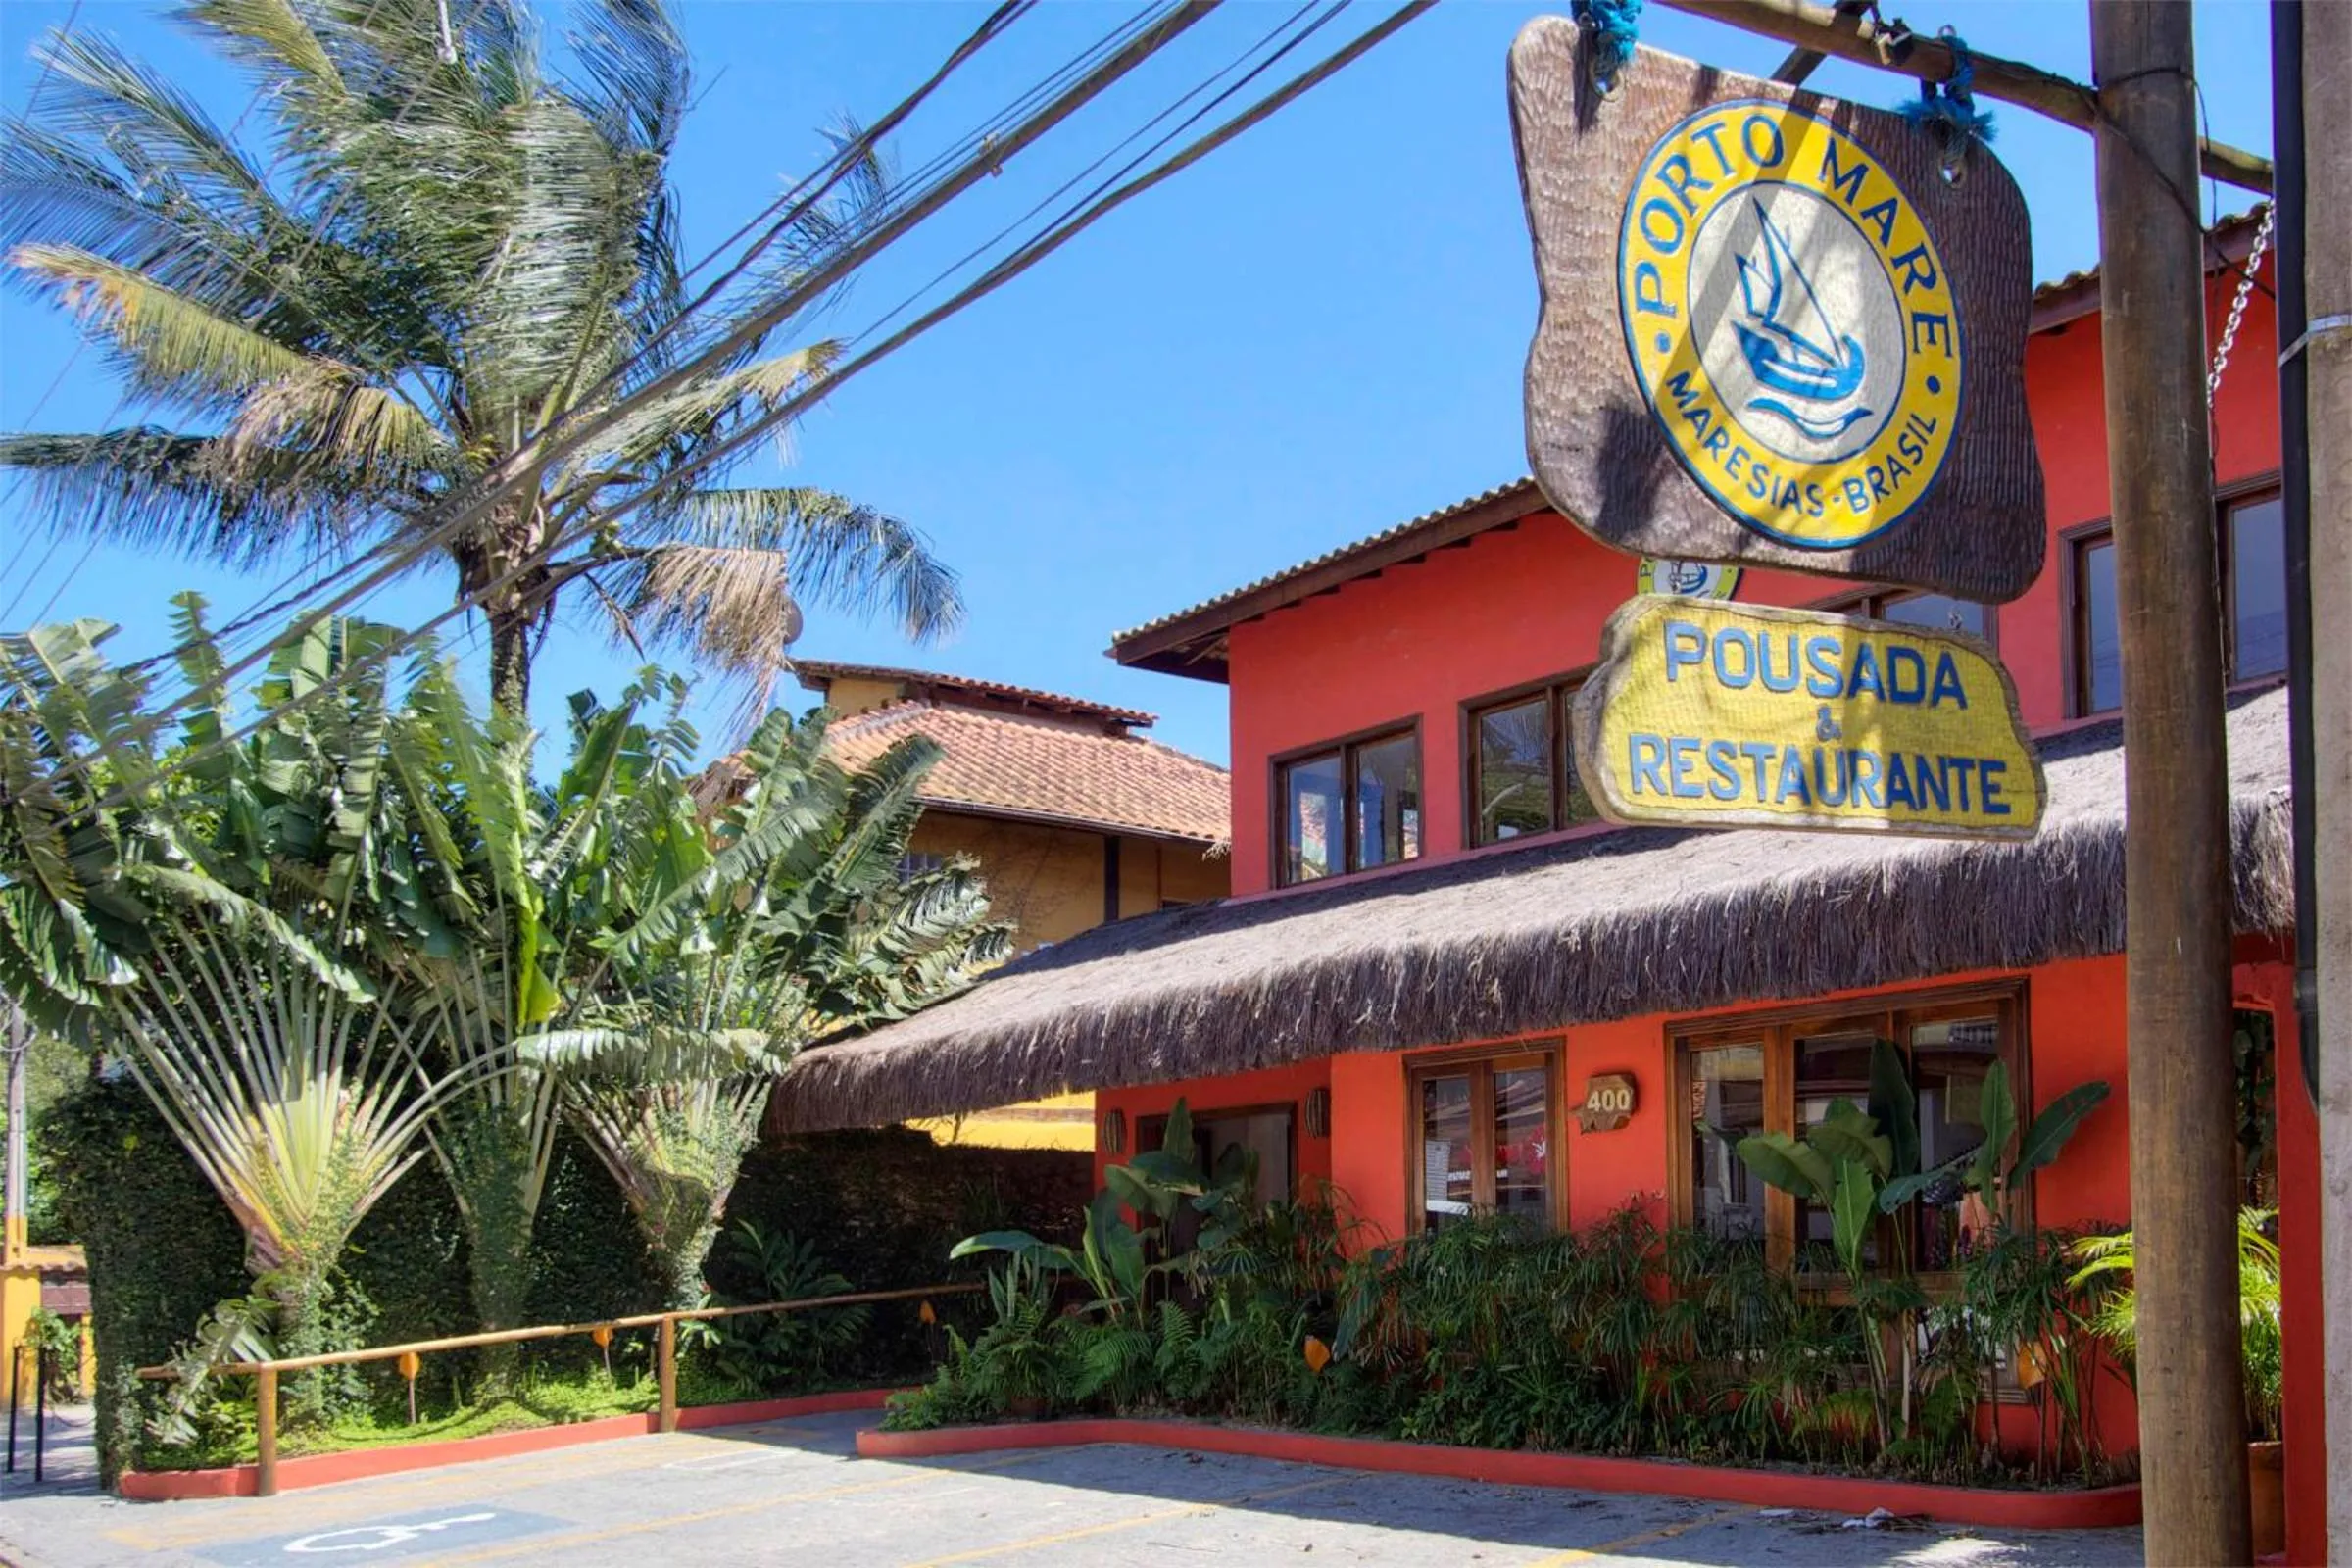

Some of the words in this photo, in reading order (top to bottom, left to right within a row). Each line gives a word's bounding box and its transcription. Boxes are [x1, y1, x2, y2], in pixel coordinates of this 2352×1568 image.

[1635, 113, 1785, 318] PORTO
[1819, 137, 1953, 358] MARE
[1665, 370, 1825, 517] MARESIAS
[1842, 413, 1937, 514] BRASIL
[1663, 619, 1968, 709] POUSADA
[1815, 705, 1844, 742] &
[1628, 732, 2012, 815] RESTAURANTE
[1587, 1089, 1631, 1112] 400
